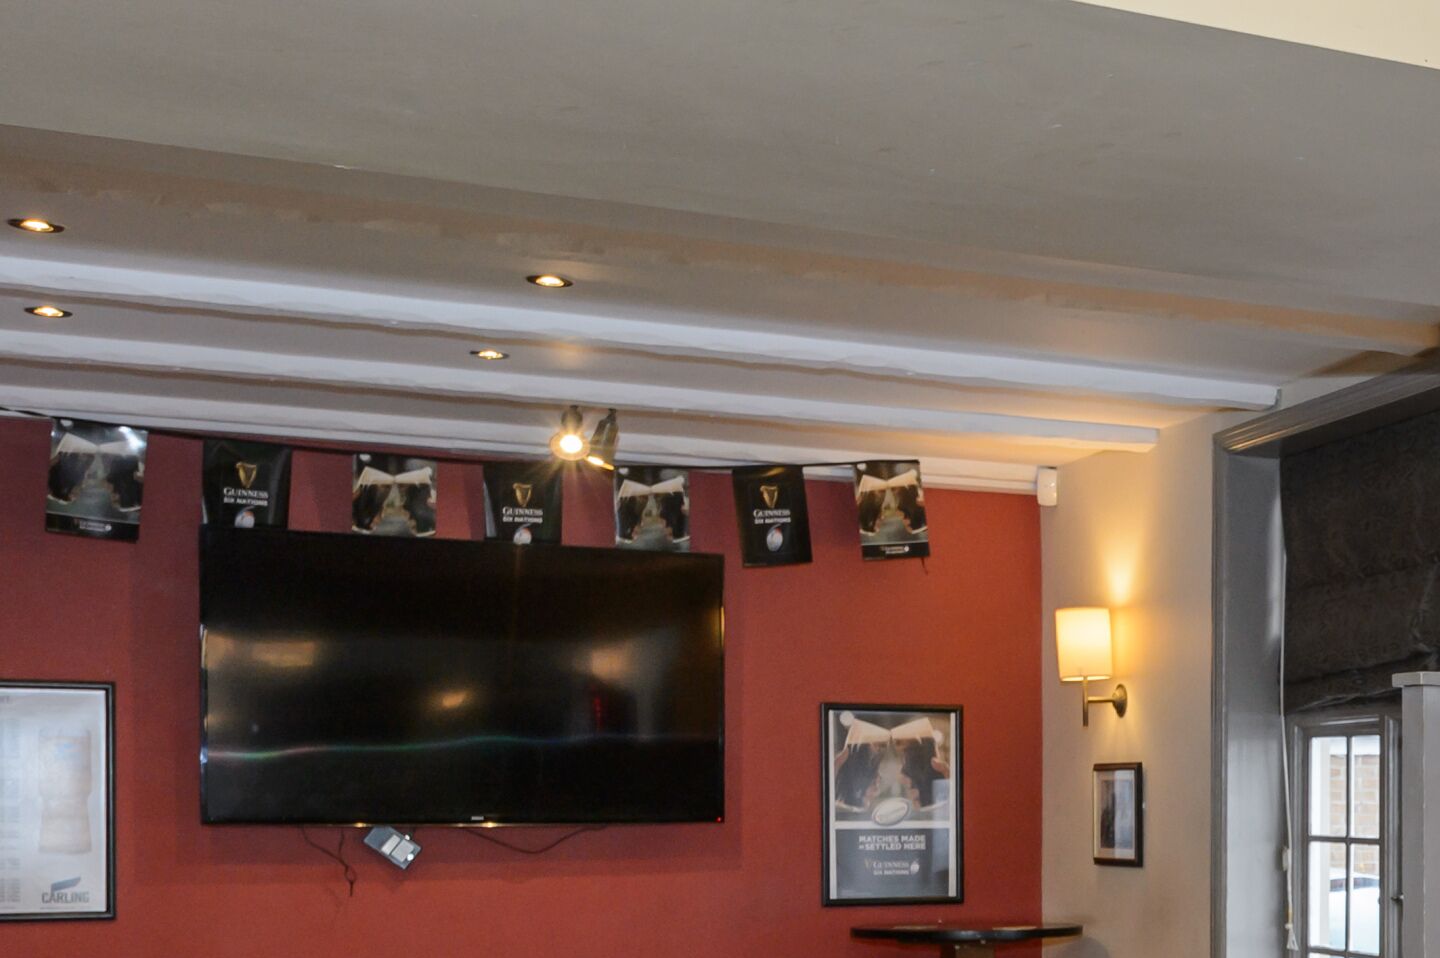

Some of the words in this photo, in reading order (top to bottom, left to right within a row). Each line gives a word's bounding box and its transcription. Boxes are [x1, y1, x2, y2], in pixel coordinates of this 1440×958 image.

[223, 486, 269, 499] GUINNESS
[236, 497, 269, 507] NATIONS
[502, 506, 544, 517] GUINNESS
[753, 509, 791, 518] GUINNESS
[514, 516, 544, 524] NATIONS
[765, 516, 792, 524] NATIONS
[858, 834, 899, 843] MATCHES
[901, 834, 927, 843] MADE
[865, 842, 902, 852] SETTLED
[903, 842, 927, 851] HERE
[41, 890, 90, 904] CARLING
